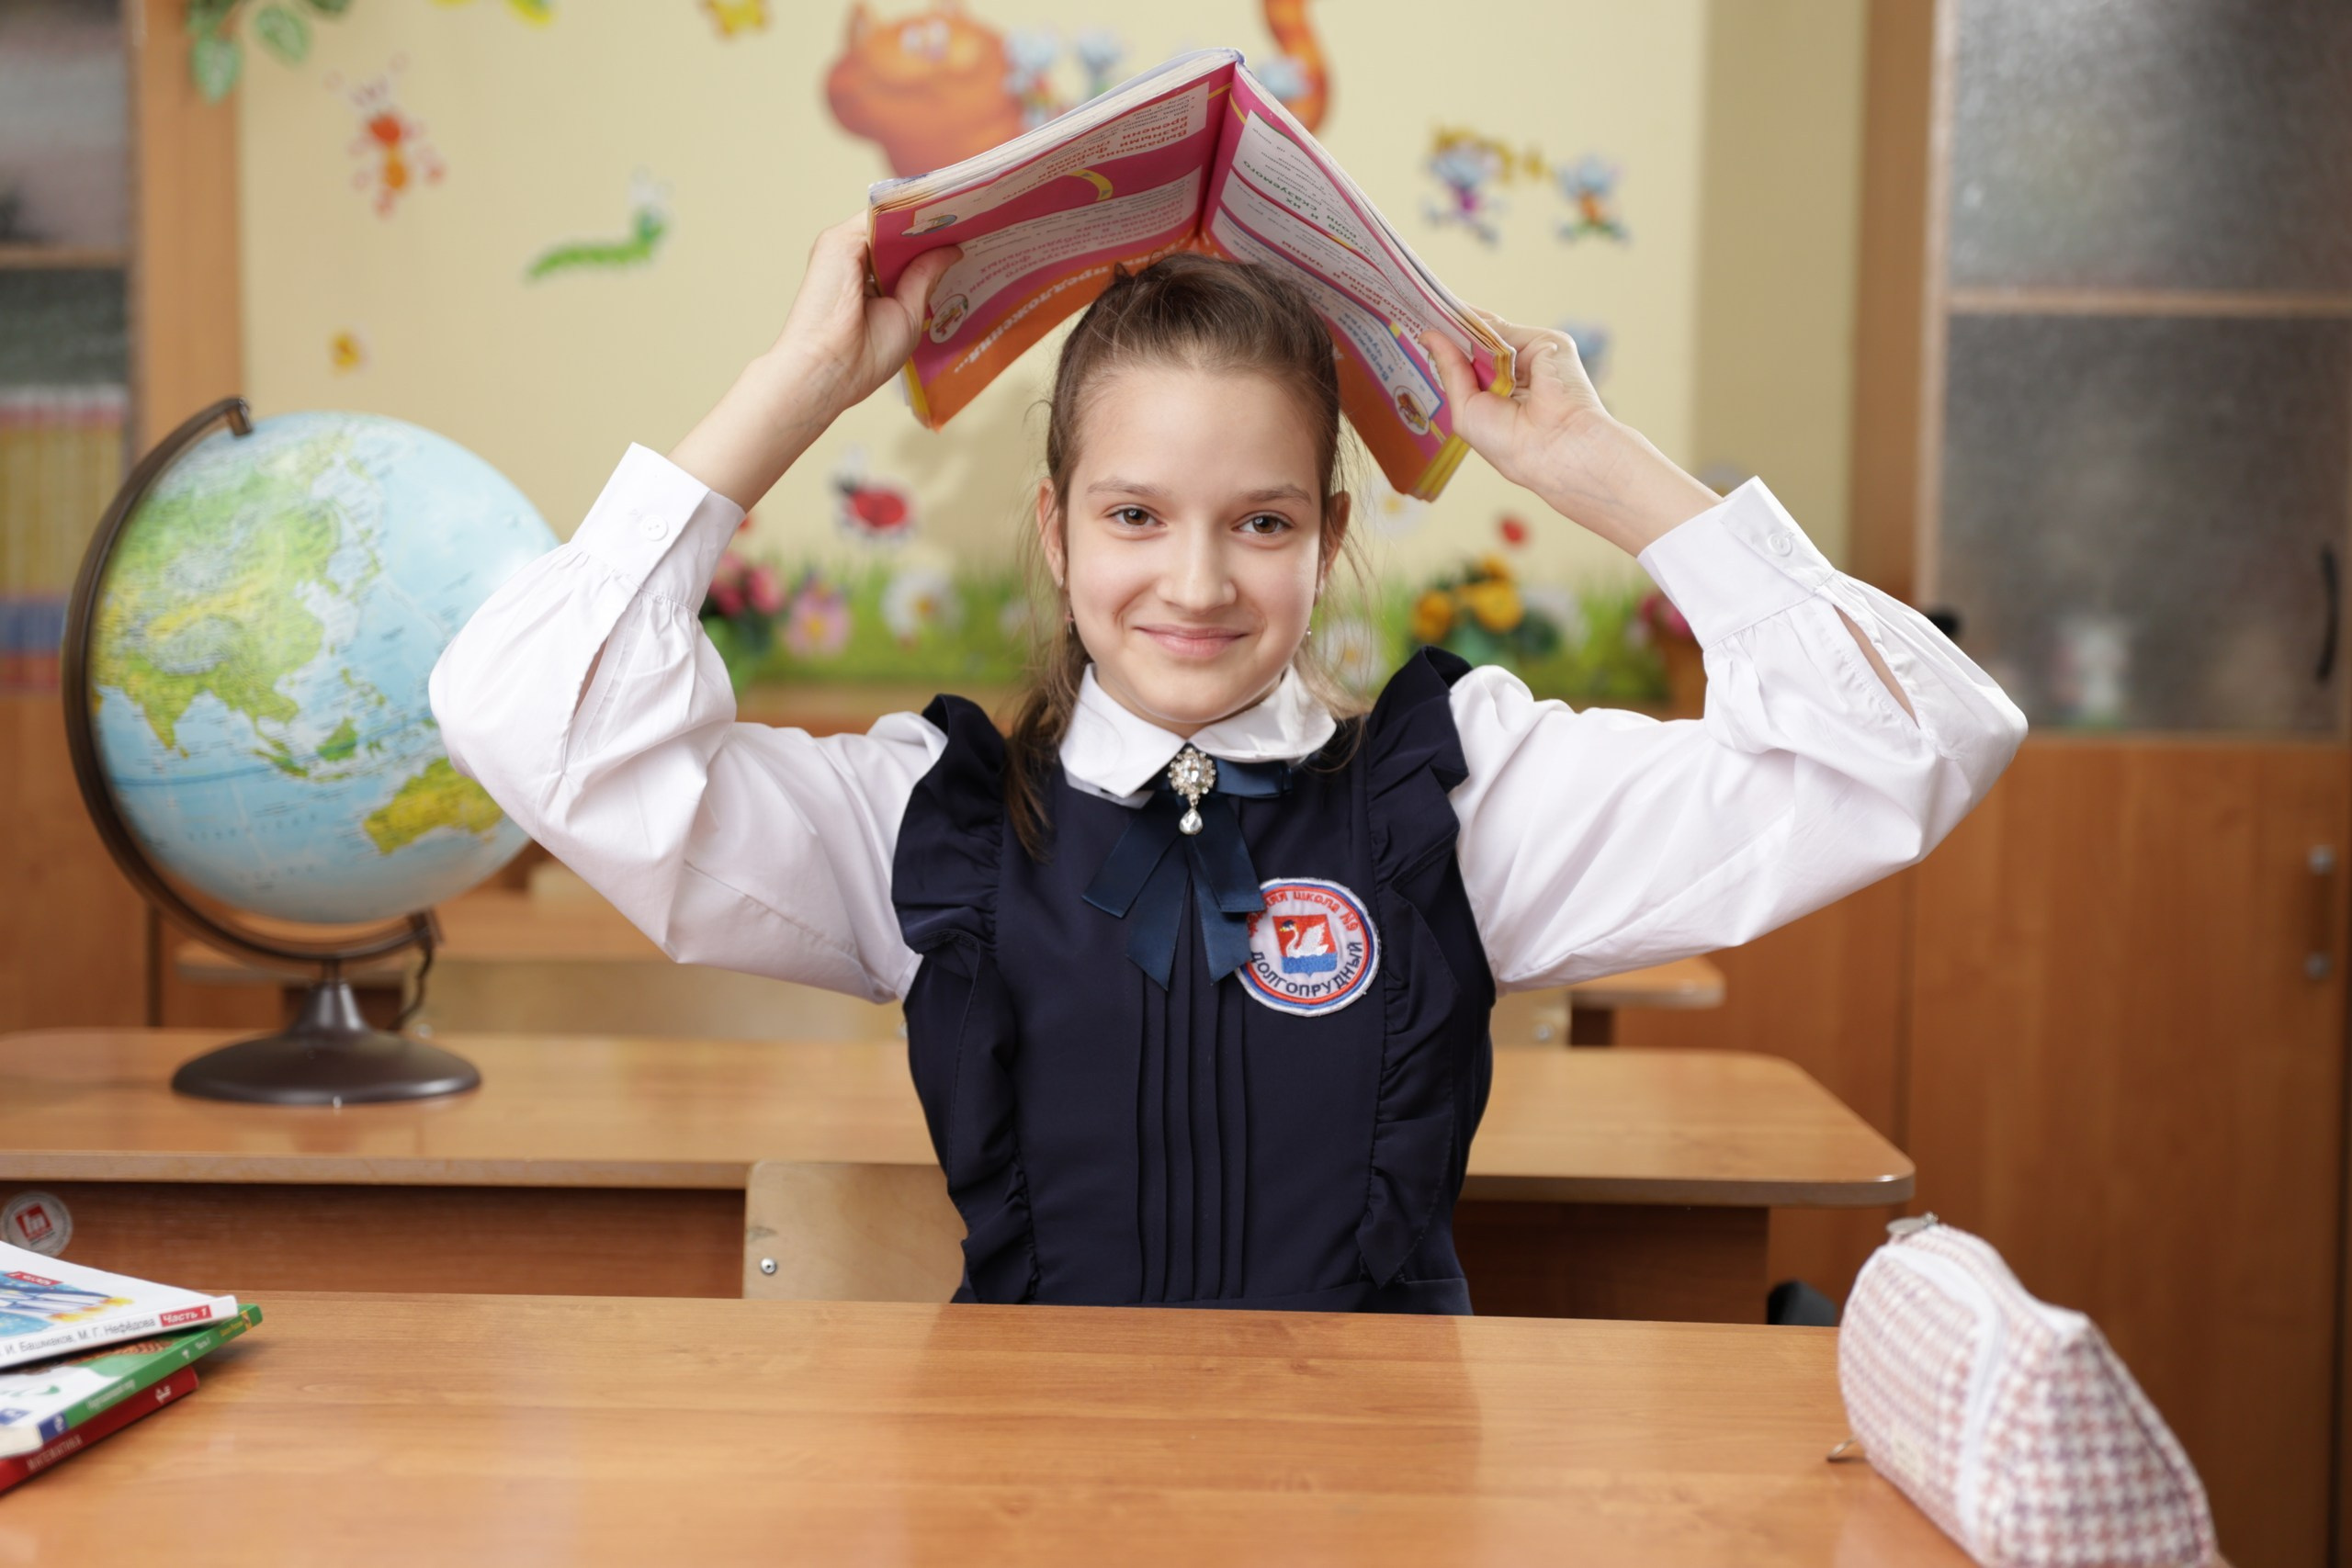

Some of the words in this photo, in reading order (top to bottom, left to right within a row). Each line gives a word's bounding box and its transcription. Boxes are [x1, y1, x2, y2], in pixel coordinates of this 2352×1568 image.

[1120, 121, 1188, 147] разными
[1123, 116, 1188, 140] времени
[1046, 141, 1110, 170] глаголов
[1097, 130, 1188, 160] Выражение
[1037, 147, 1108, 179] формами
[1002, 160, 1086, 200] сказуемого
[1243, 160, 1317, 211] сказуемого
[1076, 197, 1183, 232] предложениях
[1286, 197, 1301, 209] их
[1098, 216, 1182, 246] Выражение
[979, 231, 1091, 274] побудительных
[1005, 244, 1088, 278] сказуемого
[1282, 240, 1324, 268] члены
[969, 254, 1031, 293] формами
[1350, 283, 1380, 306] речи
[1250, 942, 1363, 997] ДОЛГОПРУДНЫЙ
[163, 1311, 198, 1324] Часть
[200, 1307, 208, 1316] 1
[19, 1335, 74, 1352] Башмаков,
[77, 1331, 90, 1340] М.
[92, 1327, 103, 1337] Г.
[105, 1319, 156, 1336] Нефёдова
